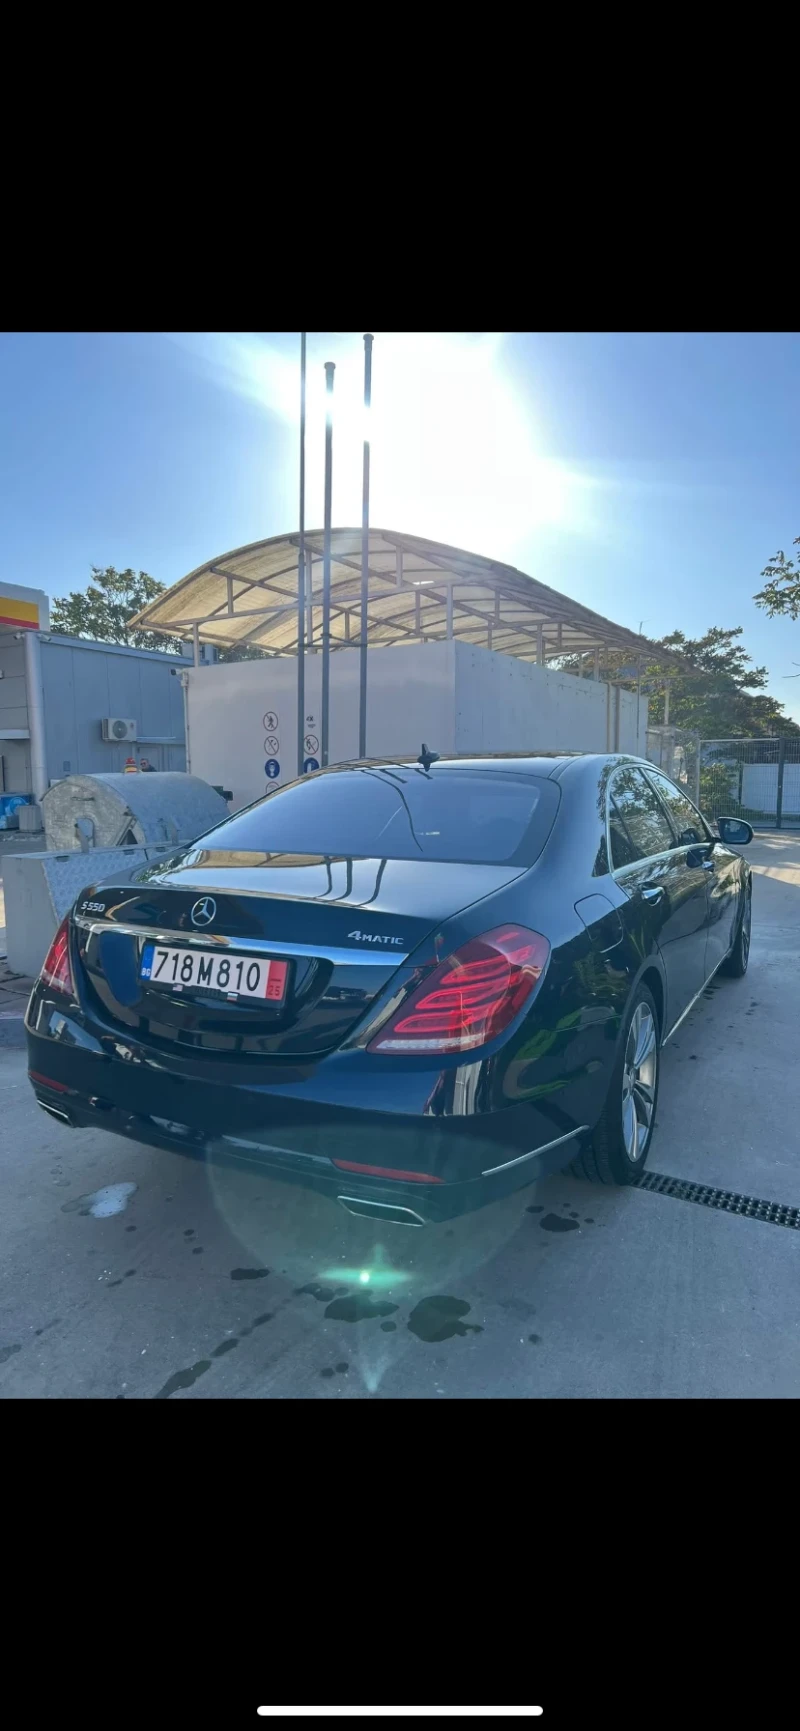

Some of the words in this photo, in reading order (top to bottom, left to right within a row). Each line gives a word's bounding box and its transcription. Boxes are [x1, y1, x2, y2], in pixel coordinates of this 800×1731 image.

[81, 901, 105, 912] S550
[347, 930, 404, 945] 4MATIC
[141, 967, 151, 977] BG
[154, 951, 261, 992] 718M810
[268, 985, 281, 997] 25
